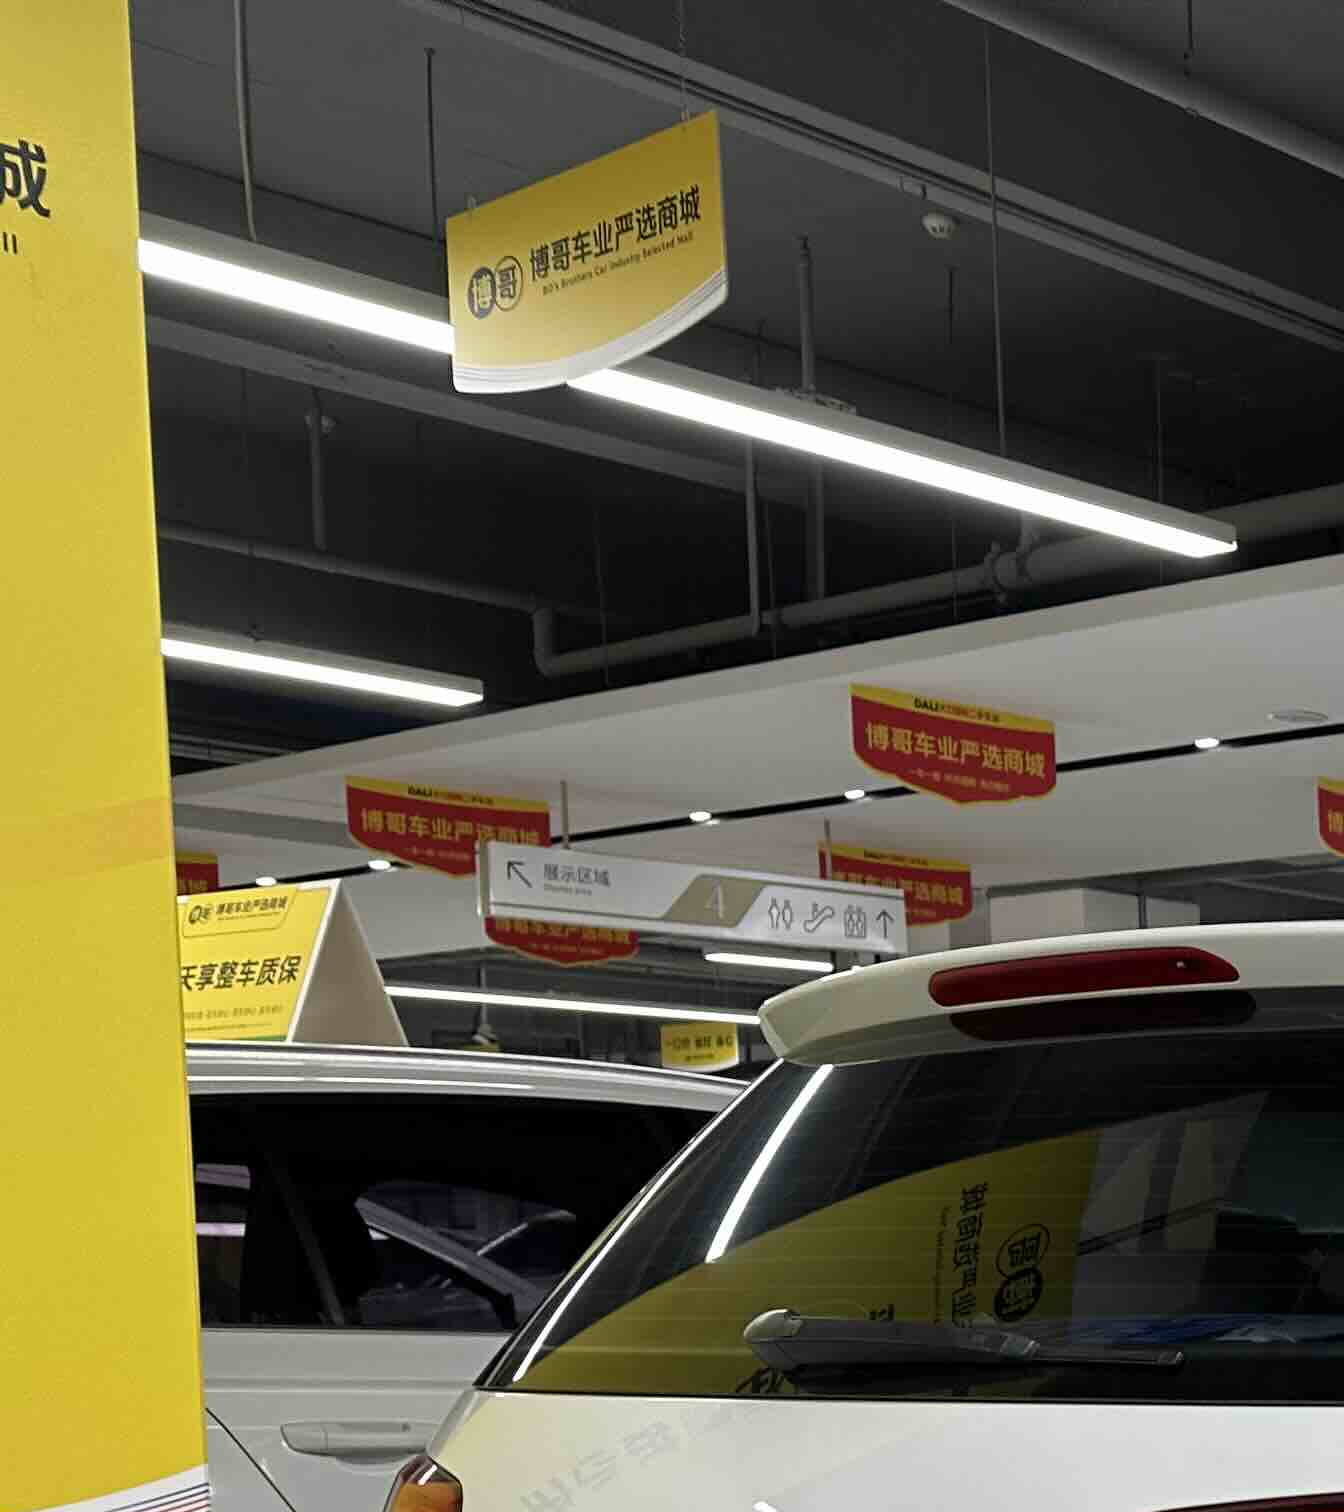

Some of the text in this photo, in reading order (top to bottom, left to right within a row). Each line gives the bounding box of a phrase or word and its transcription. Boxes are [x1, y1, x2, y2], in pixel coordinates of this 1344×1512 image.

[529, 184, 701, 281] 博哥车业严选商城
[864, 720, 1046, 779] 博哥车业严选商城
[543, 863, 611, 888] 展示区域
[181, 955, 302, 992] 天享整车质保
